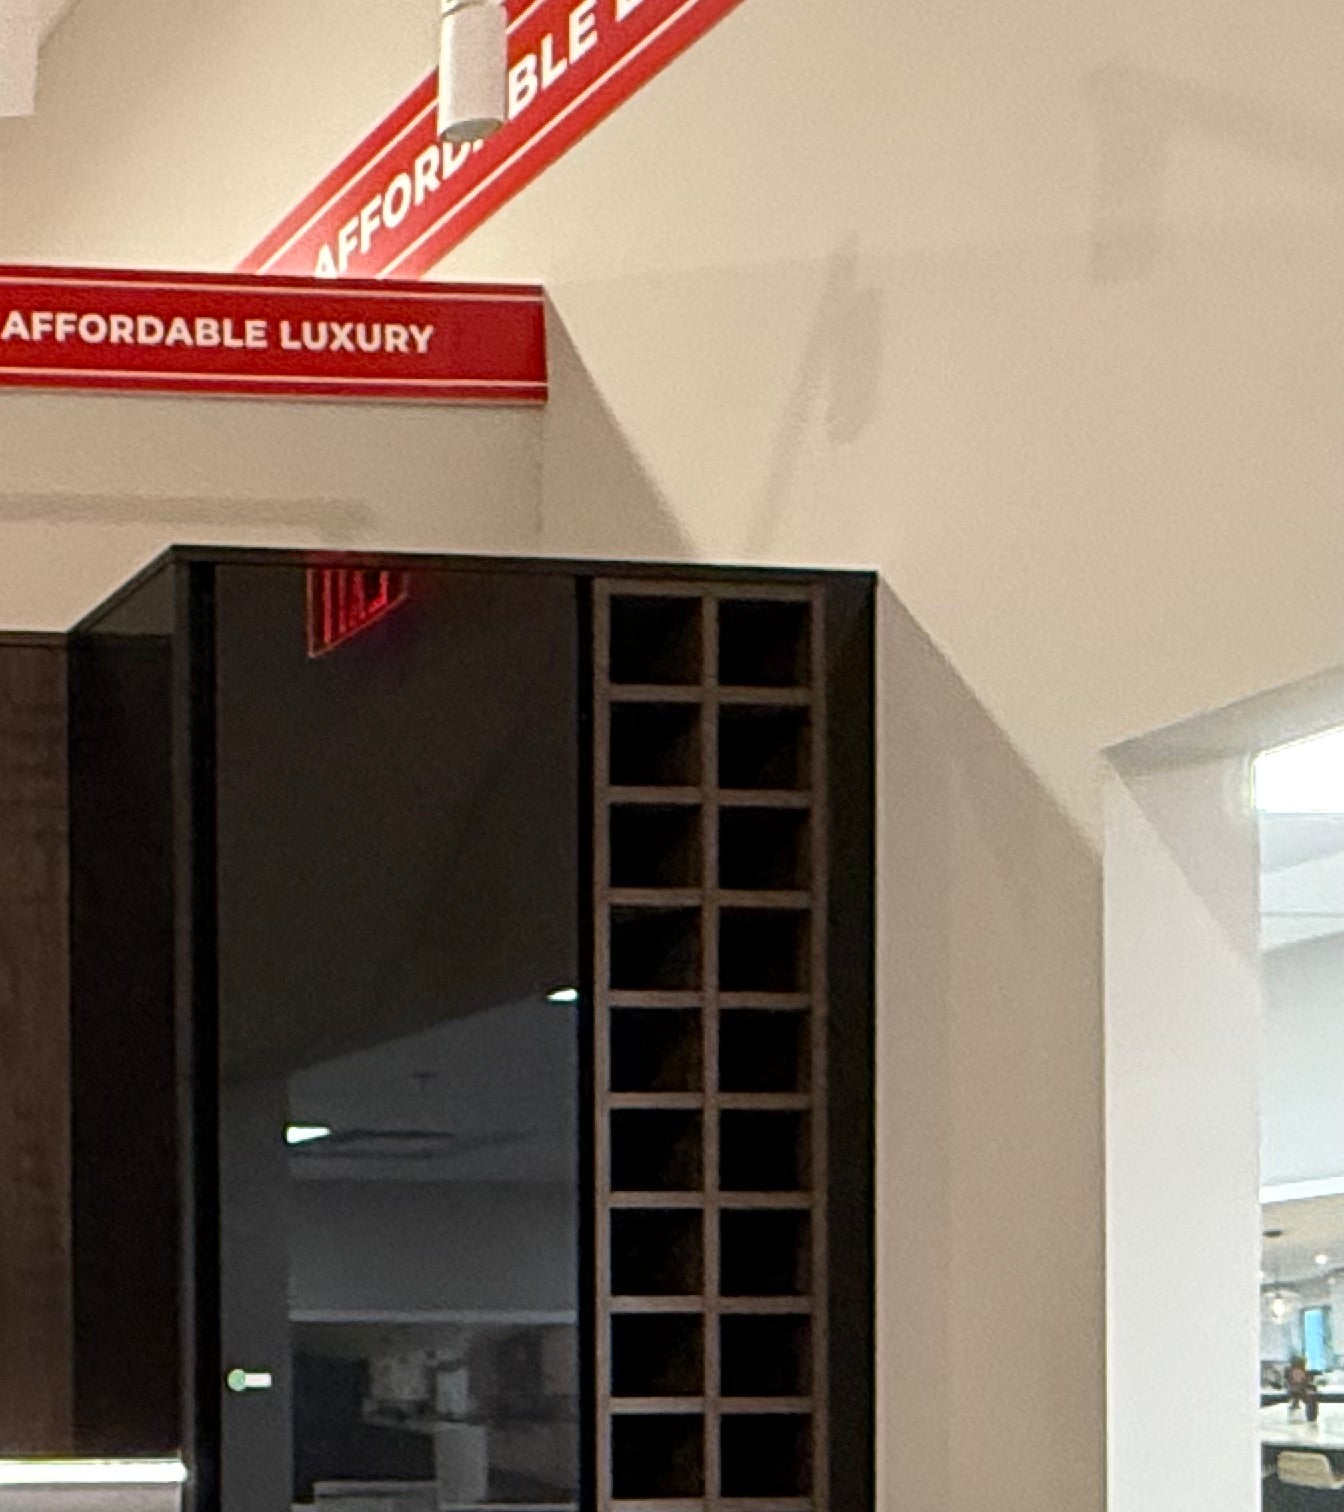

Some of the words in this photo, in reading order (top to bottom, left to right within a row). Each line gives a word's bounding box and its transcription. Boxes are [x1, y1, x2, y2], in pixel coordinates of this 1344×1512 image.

[315, 0, 598, 277] AFFORDBLE
[0, 310, 268, 348] AFFORDABLE
[280, 320, 434, 353] LUXURY
